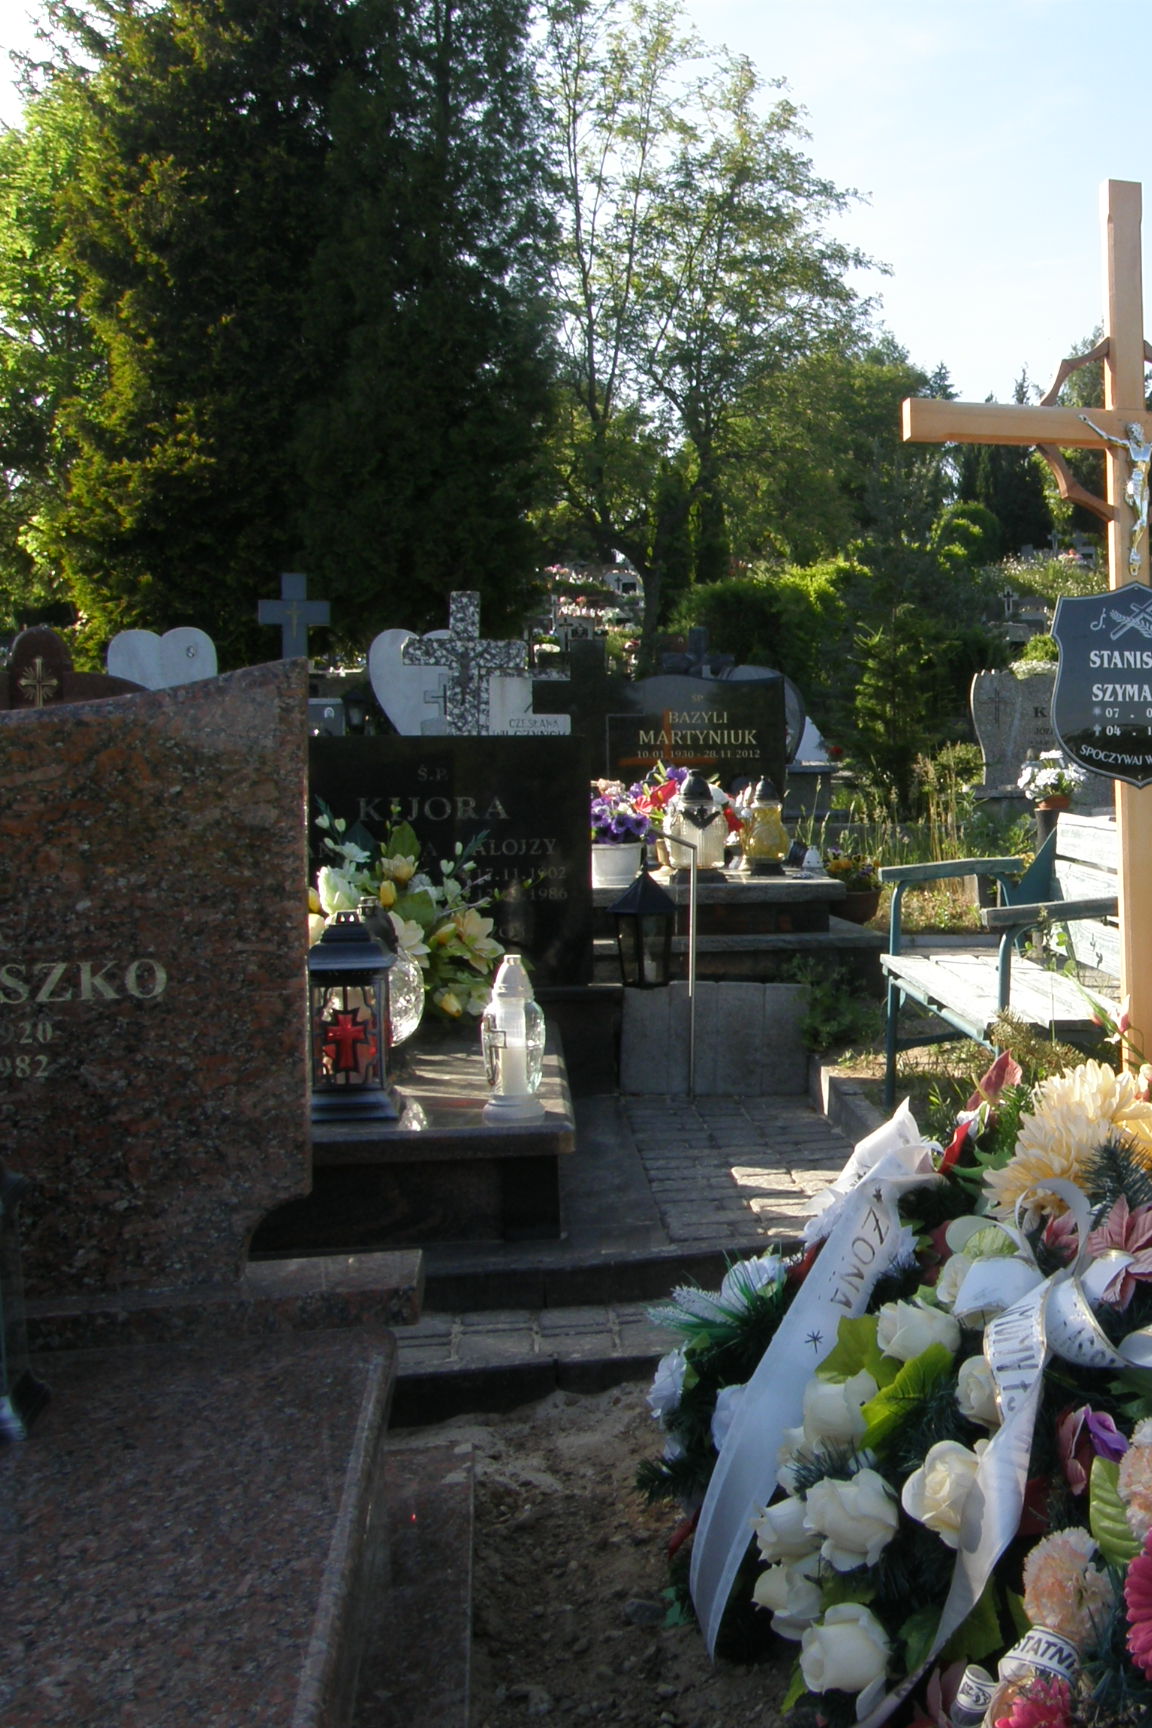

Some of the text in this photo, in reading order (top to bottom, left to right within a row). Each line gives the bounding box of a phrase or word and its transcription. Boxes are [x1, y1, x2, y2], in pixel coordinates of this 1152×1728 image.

[668, 712, 728, 724] BAZYLI
[639, 730, 758, 745] MARTYNIUK
[1080, 744, 1143, 765] SPOCZYWAJ
[358, 796, 512, 821] KIJORA
